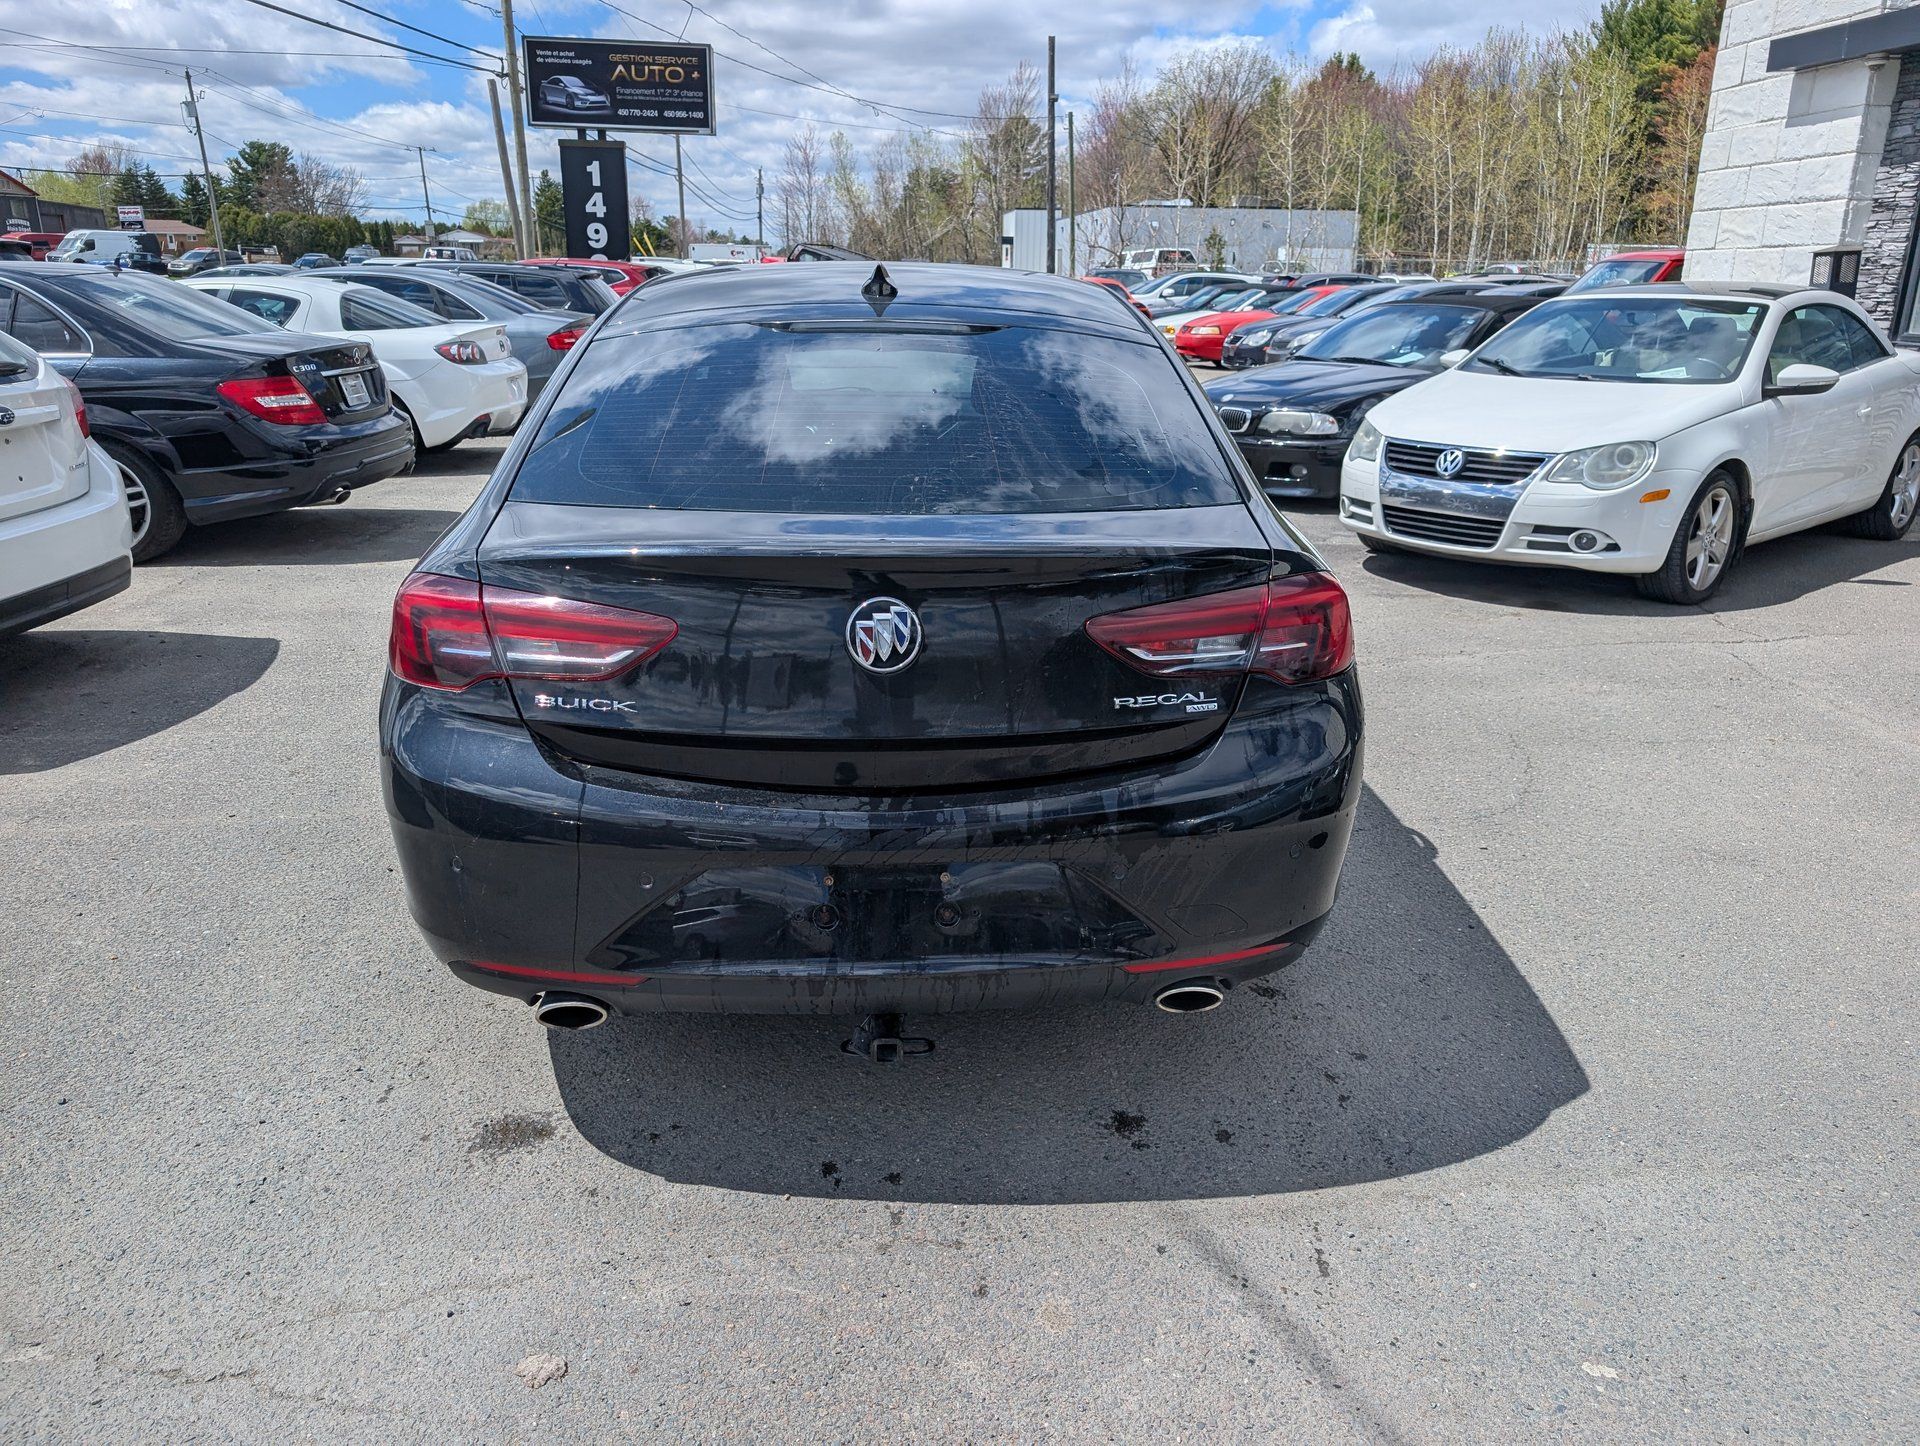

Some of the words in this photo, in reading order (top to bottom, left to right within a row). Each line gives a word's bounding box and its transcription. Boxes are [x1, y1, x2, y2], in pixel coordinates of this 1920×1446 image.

[609, 54, 653, 62] GESTION
[655, 56, 698, 64] SERVICE
[611, 64, 684, 83] AUTO
[616, 87, 656, 95] Financement
[293, 364, 316, 372] C300
[535, 695, 638, 713] BUICK
[1113, 692, 1217, 709] REGAL
[1187, 704, 1217, 712] AWD
